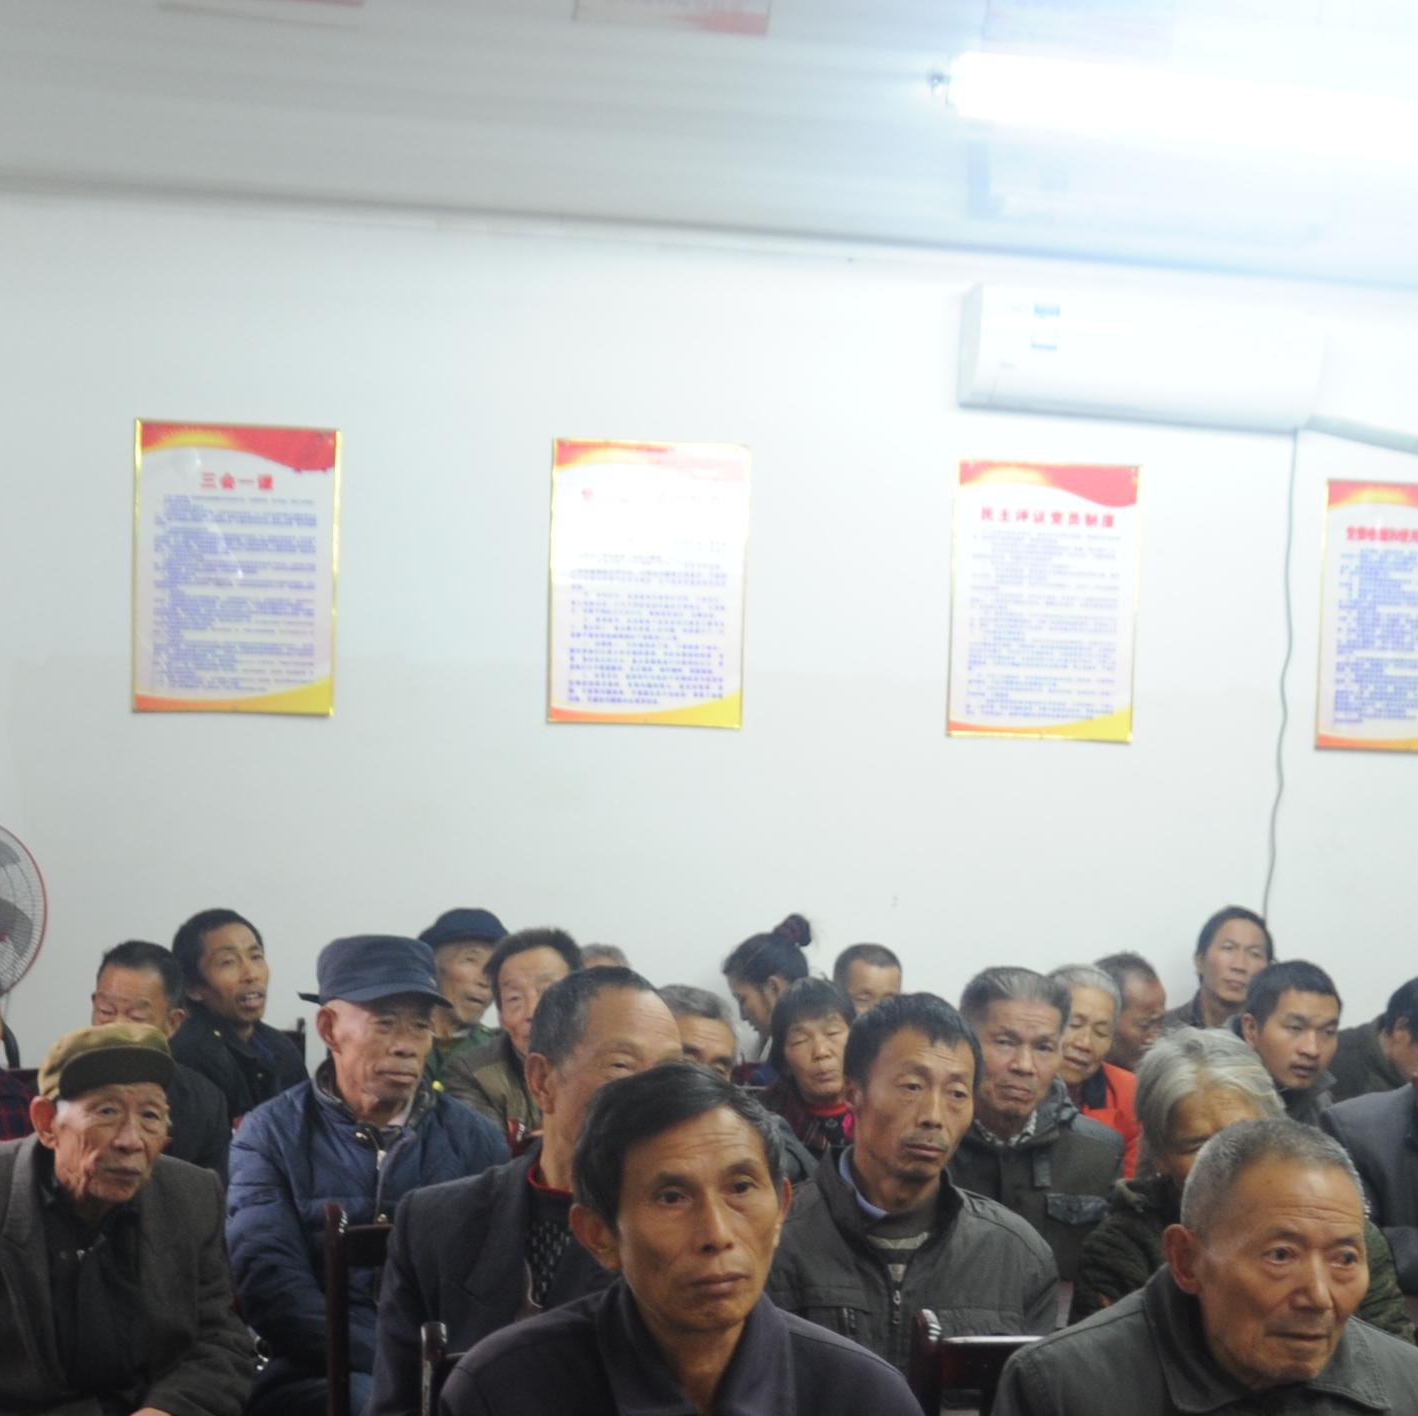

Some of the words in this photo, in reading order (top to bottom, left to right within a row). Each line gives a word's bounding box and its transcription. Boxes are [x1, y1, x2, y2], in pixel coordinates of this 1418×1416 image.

[200, 471, 275, 492] 三会一课
[981, 506, 1116, 529] 民主评议党员制度
